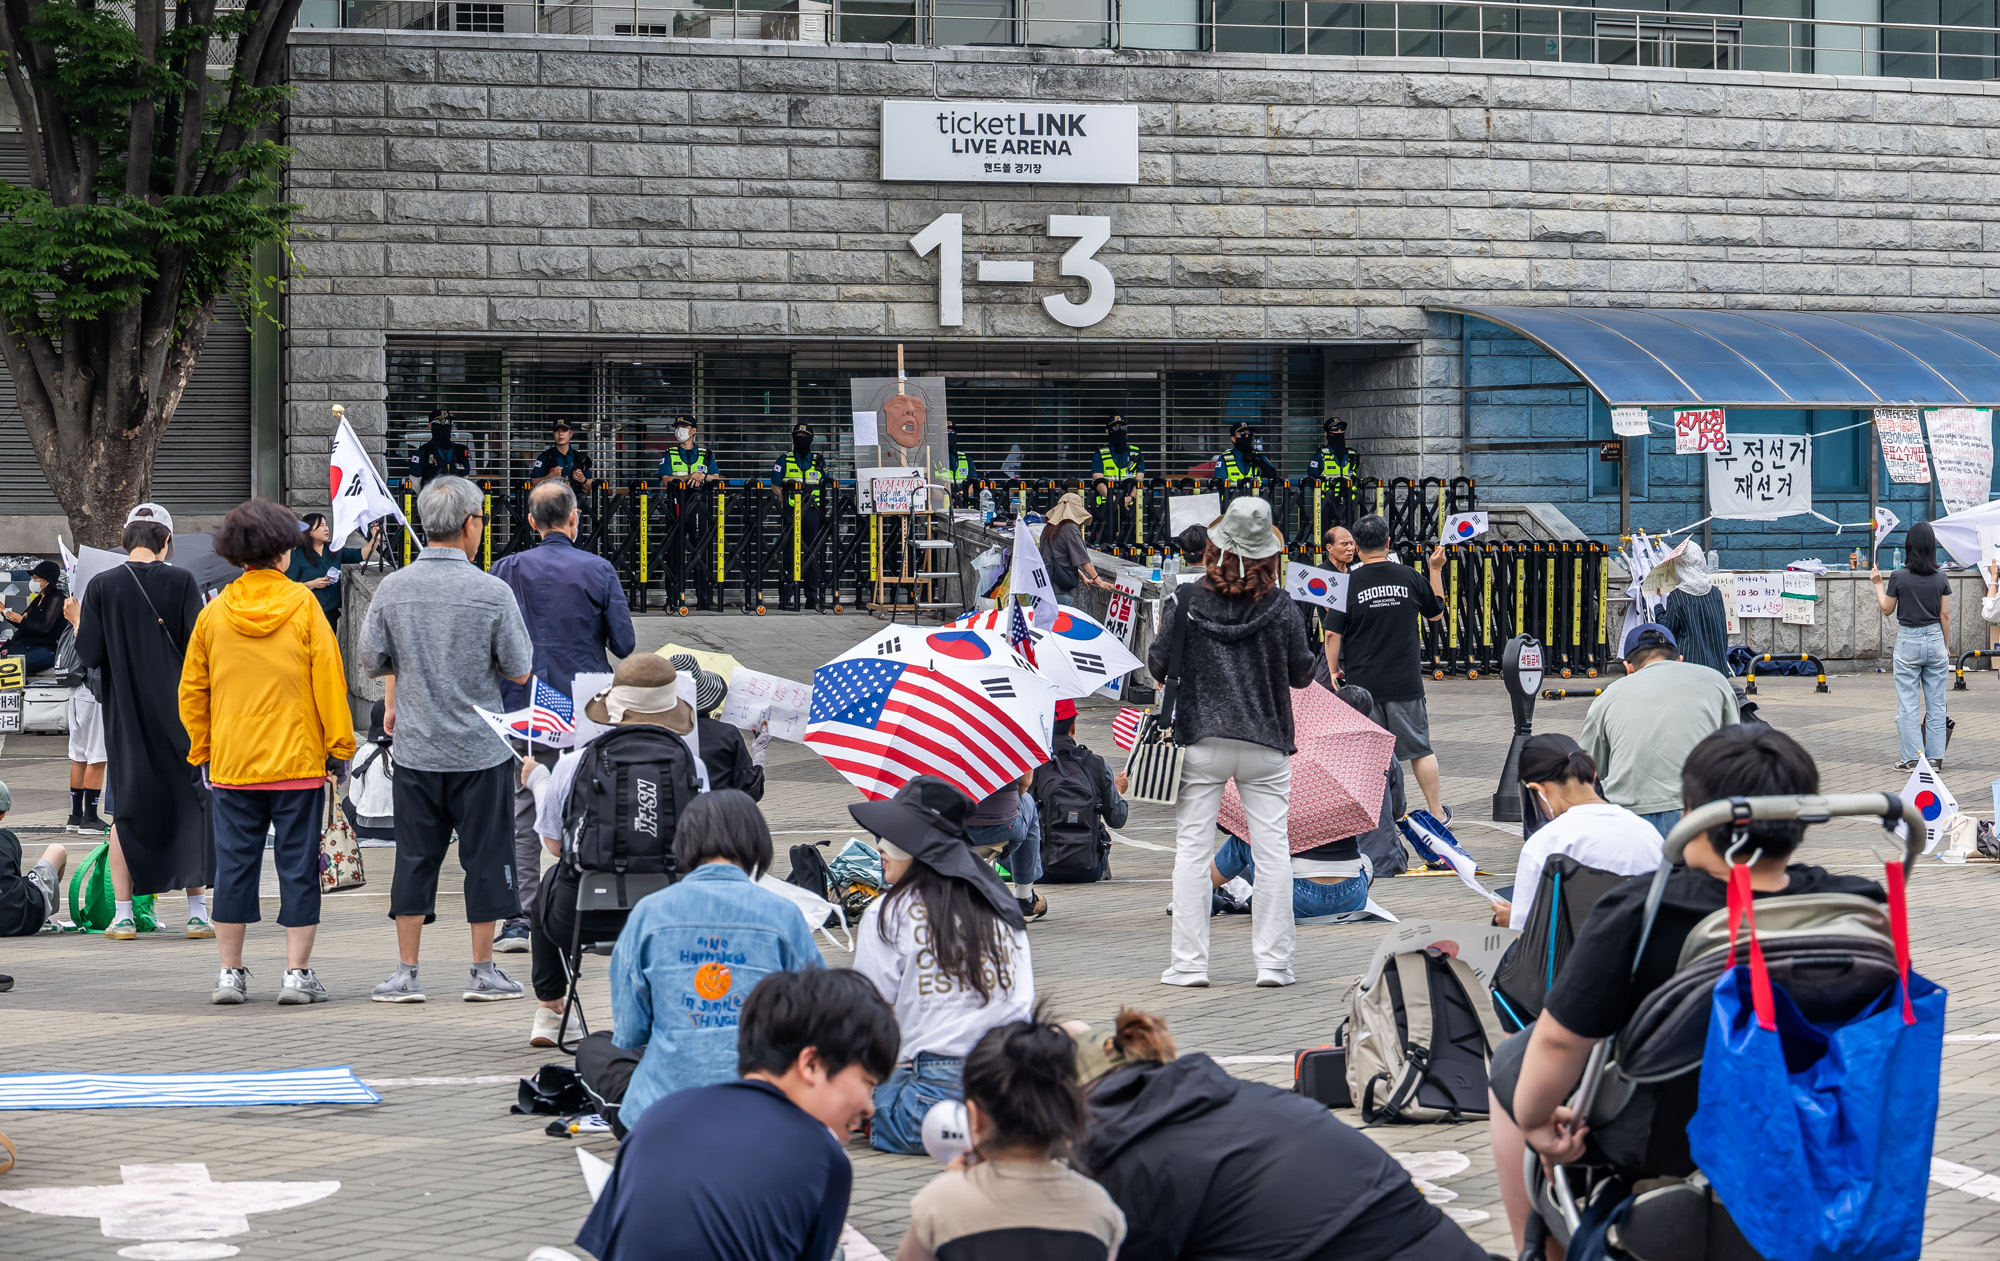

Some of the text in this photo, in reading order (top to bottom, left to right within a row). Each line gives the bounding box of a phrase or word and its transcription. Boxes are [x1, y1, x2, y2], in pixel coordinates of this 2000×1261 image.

[936, 111, 1087, 137] ticketLINK
[952, 138, 1072, 156] LIVE ARENA
[984, 162, 1042, 174] 핸드볼 경기장
[1698, 431, 1726, 451] D-8
[1733, 472, 1792, 502] 재선거
[1357, 585, 1408, 604] SHOHOKU
